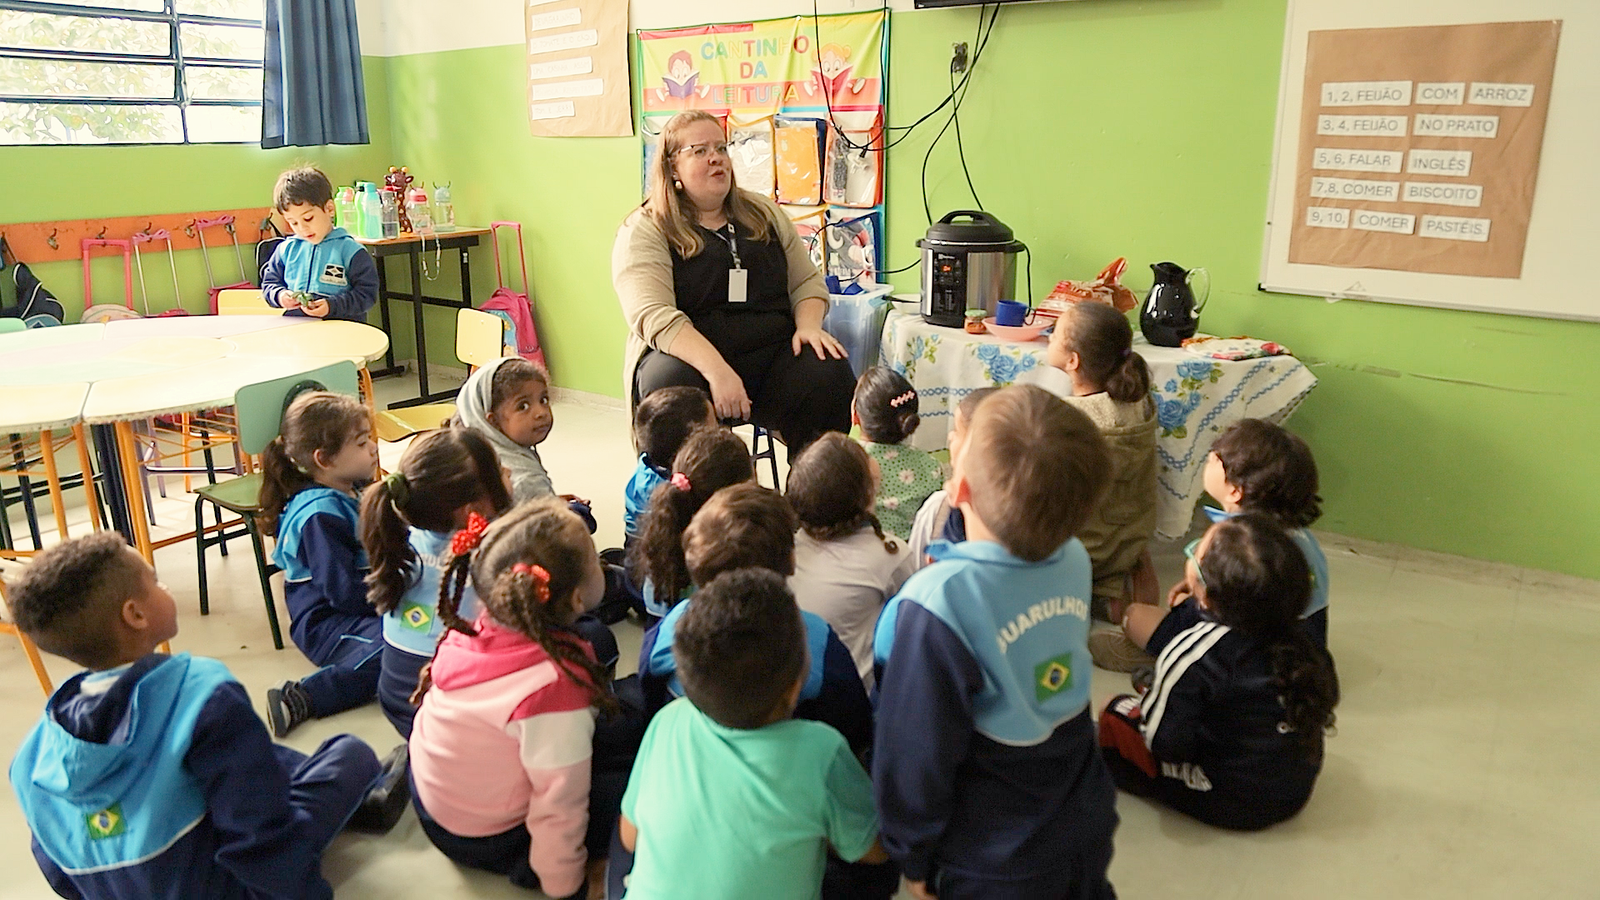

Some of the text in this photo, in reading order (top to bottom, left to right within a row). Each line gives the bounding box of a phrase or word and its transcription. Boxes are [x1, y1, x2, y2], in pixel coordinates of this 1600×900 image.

[701, 35, 809, 60] CANTINHO
[740, 61, 768, 79] DA
[713, 84, 800, 104] LEITURA
[1328, 87, 1528, 103] 1, 2, FEIJÃO COM ARROZ
[1323, 118, 1495, 132] 3, 4, FEIJÃO NO PRATO
[1319, 153, 1466, 171] 5, 6, FALAR INGLÊS
[1343, 183, 1394, 197] COMER
[1409, 186, 1478, 200] BISCOITO
[1312, 211, 1323, 223] 9,
[1328, 212, 1346, 224] 10,
[1359, 214, 1409, 229] COMER
